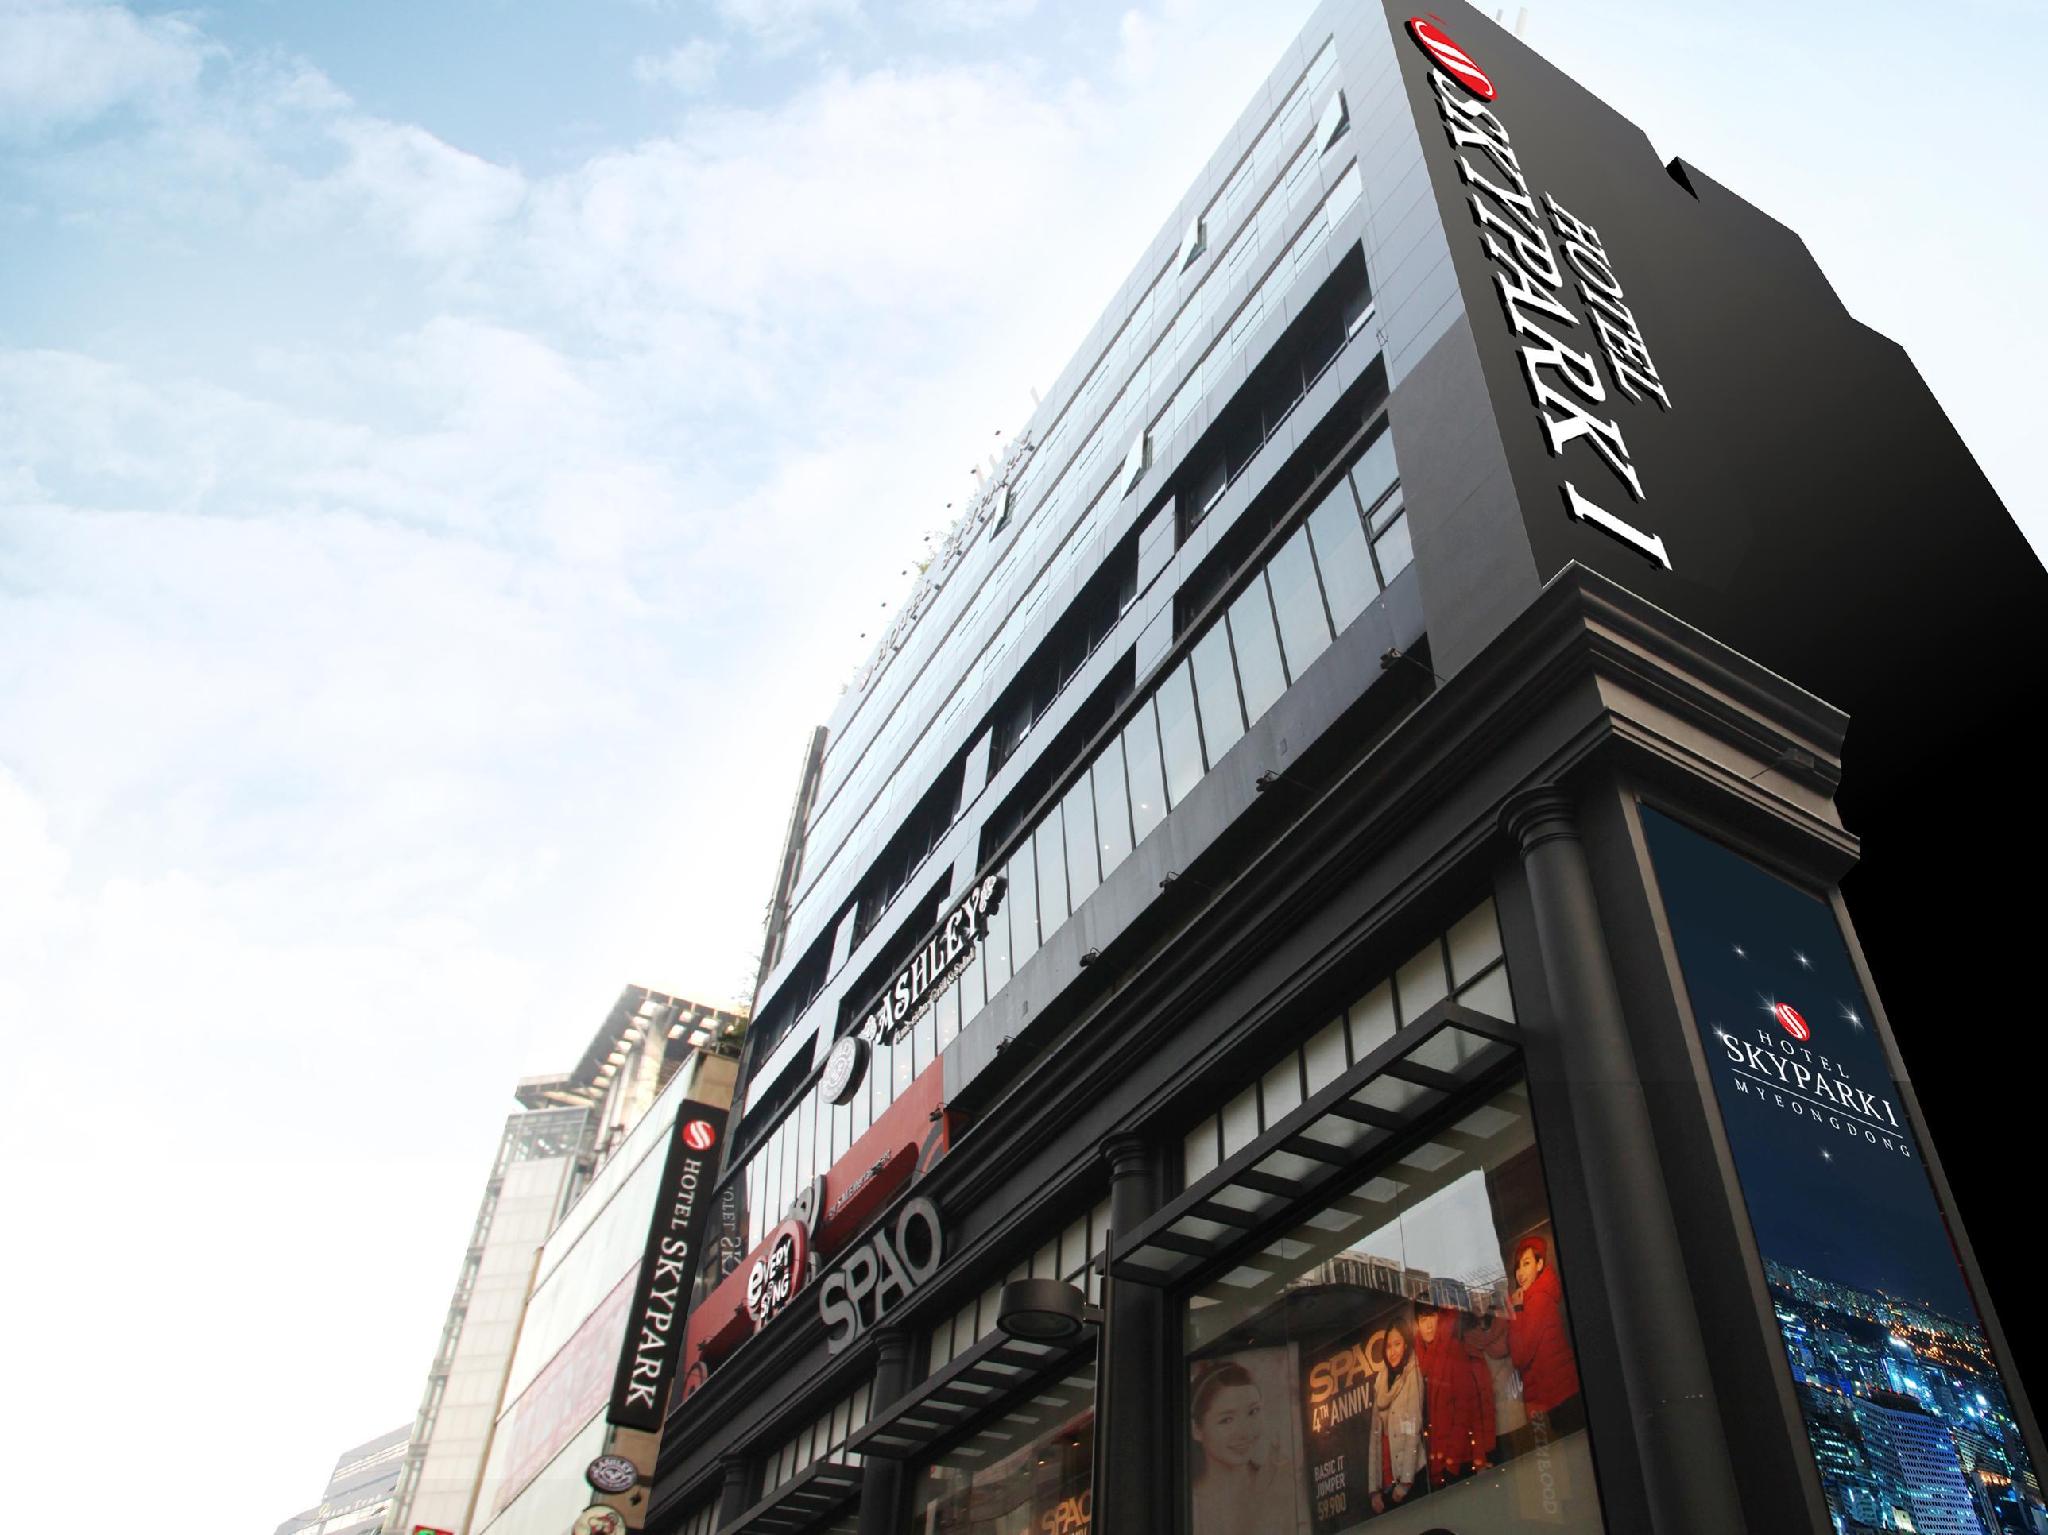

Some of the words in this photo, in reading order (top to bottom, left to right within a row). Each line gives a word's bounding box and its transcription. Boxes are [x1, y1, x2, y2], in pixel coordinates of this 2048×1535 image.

[1432, 68, 1646, 501] SKYPARK
[1544, 192, 1673, 409] HOTEL
[876, 887, 980, 1045] ASHLEY
[1722, 1033, 1885, 1122] SKYPARK
[1757, 1029, 1850, 1079] HOTEL
[1734, 1077, 1911, 1158] MYEONGDONG
[671, 1157, 703, 1231] HOTEL
[819, 1196, 943, 1355] SPAO
[626, 1236, 688, 1411] SKYPARK
[1312, 1402, 1330, 1433] 4TH
[1330, 1381, 1373, 1427] ANNIV.
[1314, 1458, 1336, 1482] BASIC
[1316, 1473, 1346, 1499] JUMPER
